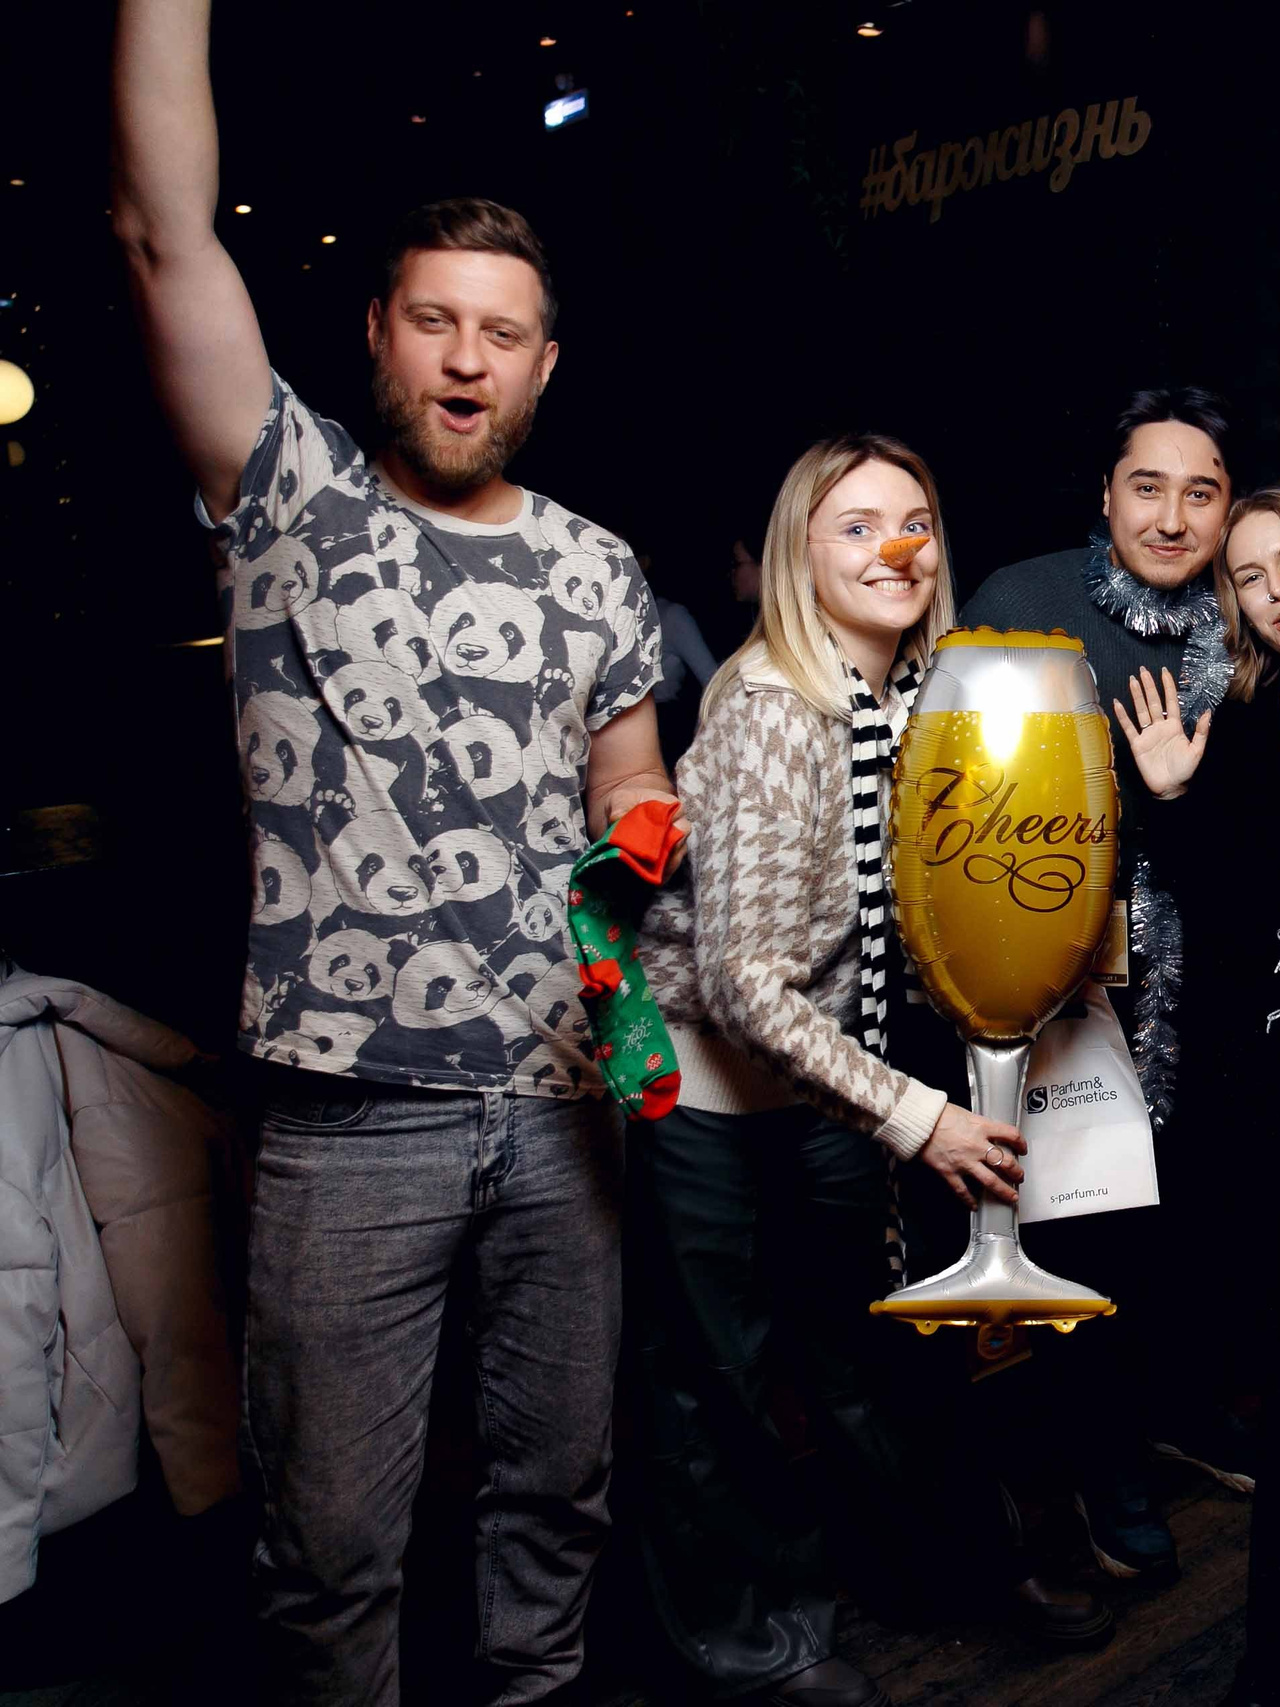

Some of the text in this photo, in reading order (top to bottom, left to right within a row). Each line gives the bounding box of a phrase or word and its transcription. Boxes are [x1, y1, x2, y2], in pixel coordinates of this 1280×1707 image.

[916, 763, 1107, 867] Cheers
[1050, 1075, 1104, 1097] Parfum&
[1051, 1090, 1118, 1110] Cosmetics
[1050, 1186, 1109, 1204] s-parfum.ru
